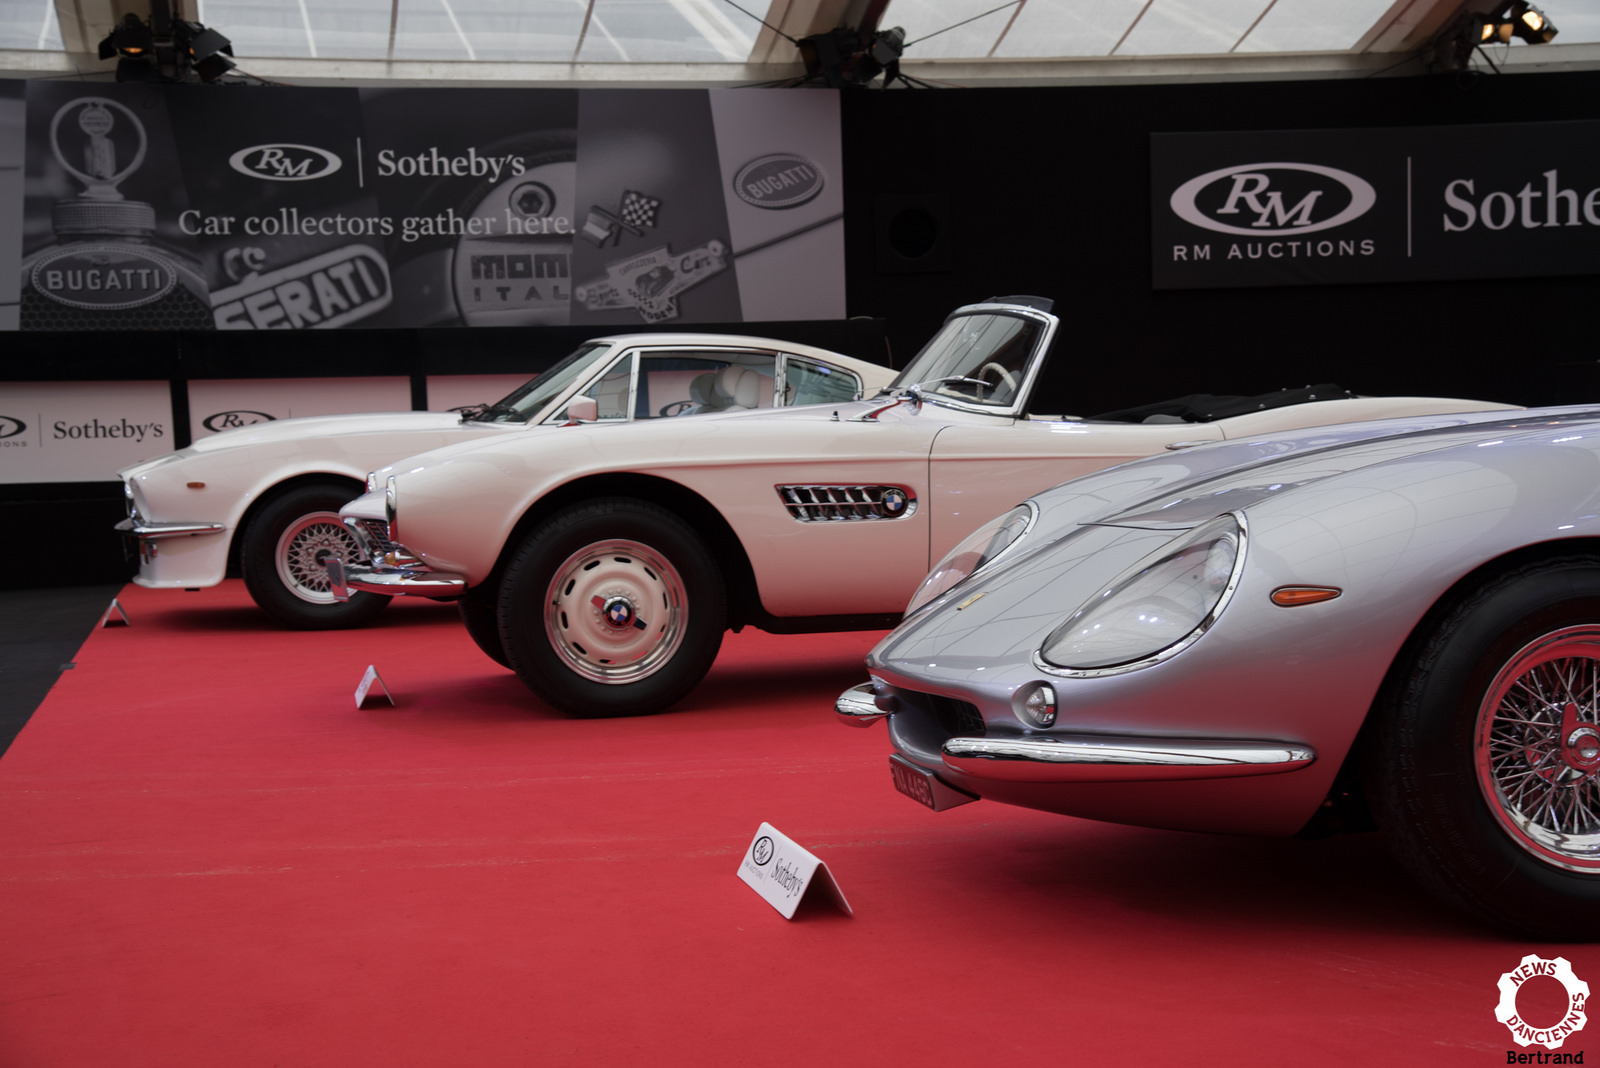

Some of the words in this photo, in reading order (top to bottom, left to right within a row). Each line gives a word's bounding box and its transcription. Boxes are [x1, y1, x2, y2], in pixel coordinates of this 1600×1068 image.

[256, 148, 313, 177] RM
[378, 147, 525, 183] Sotheby's
[746, 164, 815, 199] BUGATTI
[1216, 173, 1323, 227] RM
[178, 209, 235, 235] Car
[244, 207, 394, 236] collectors
[402, 208, 496, 242] gather
[503, 208, 576, 235] here.
[1173, 244, 1211, 262] RM
[1227, 239, 1376, 260] AUCTIONS
[46, 268, 161, 291] BUGATTI
[53, 418, 163, 443] Sotheby's
